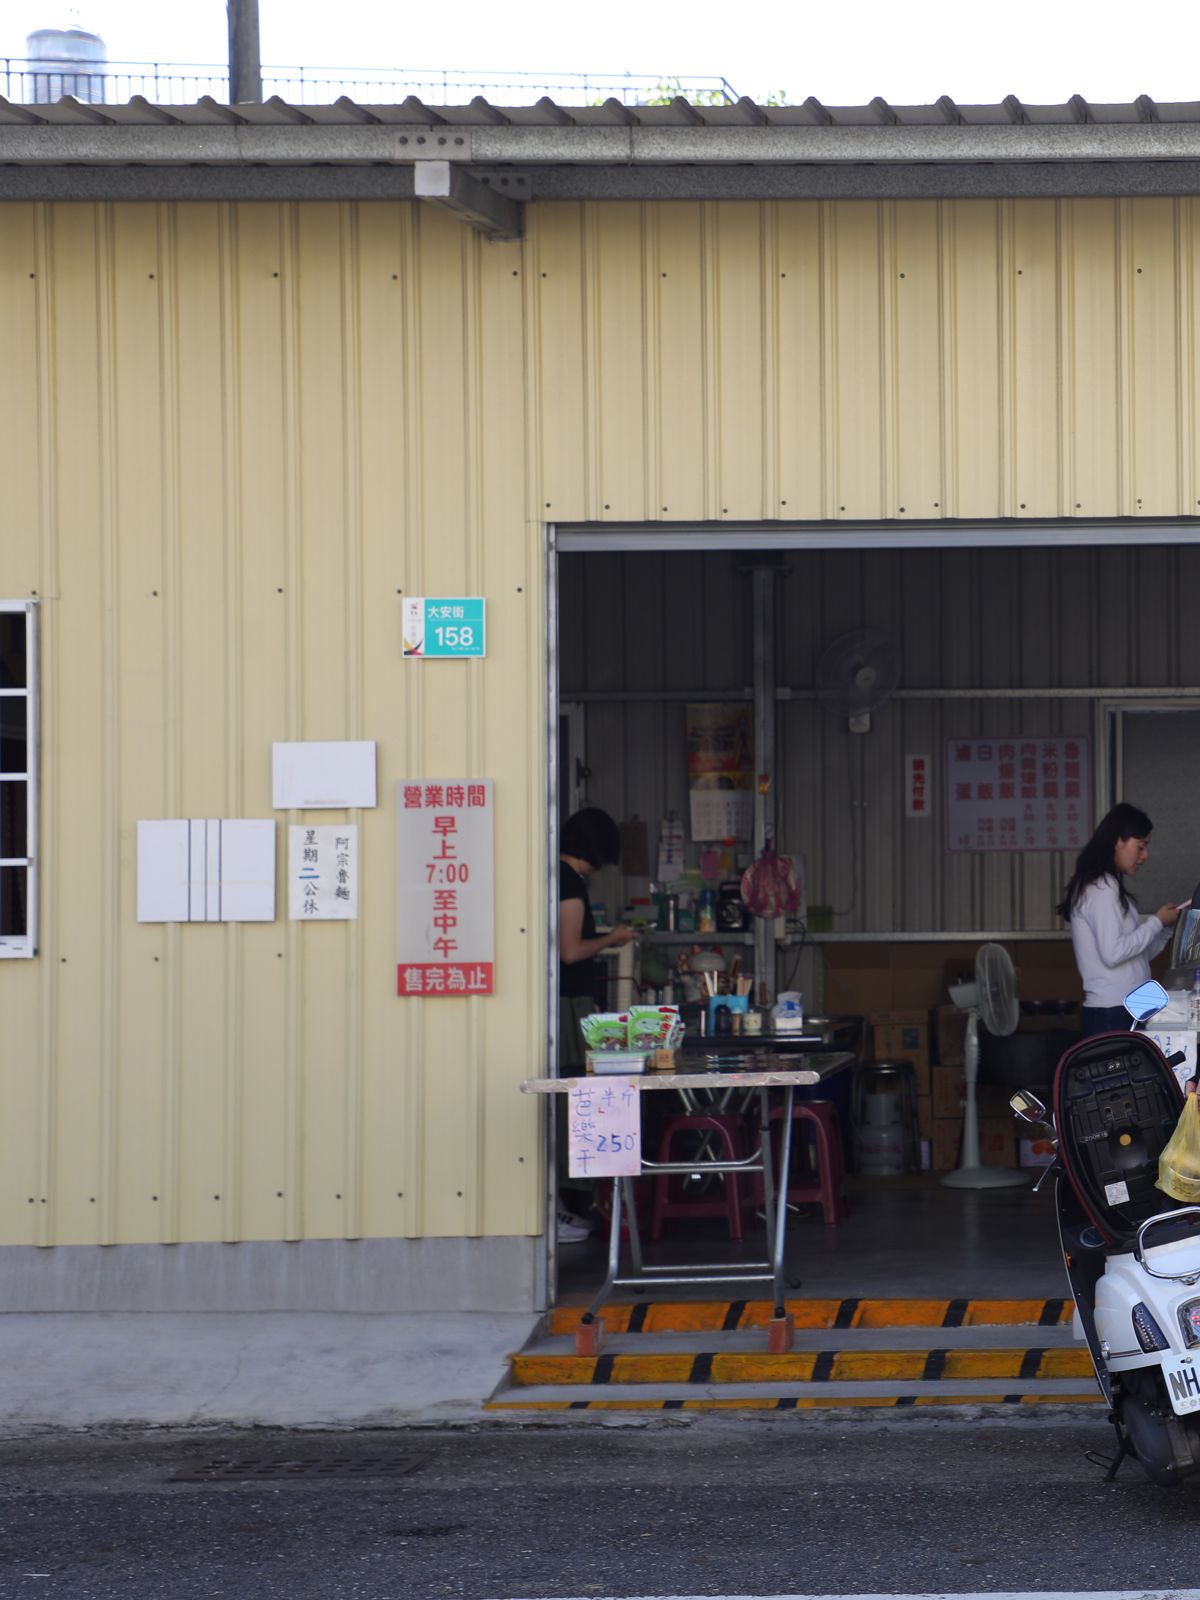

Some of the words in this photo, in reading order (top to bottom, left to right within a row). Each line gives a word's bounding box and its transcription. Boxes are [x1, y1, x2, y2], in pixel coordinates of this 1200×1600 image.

[428, 605, 464, 619] 大安街
[434, 626, 474, 647] 158
[403, 785, 486, 809] 營業時間
[298, 829, 320, 914] 星期二公休
[335, 836, 350, 901] 阿宗魯麵
[403, 966, 487, 992] 售完為止
[597, 1133, 635, 1153] 250
